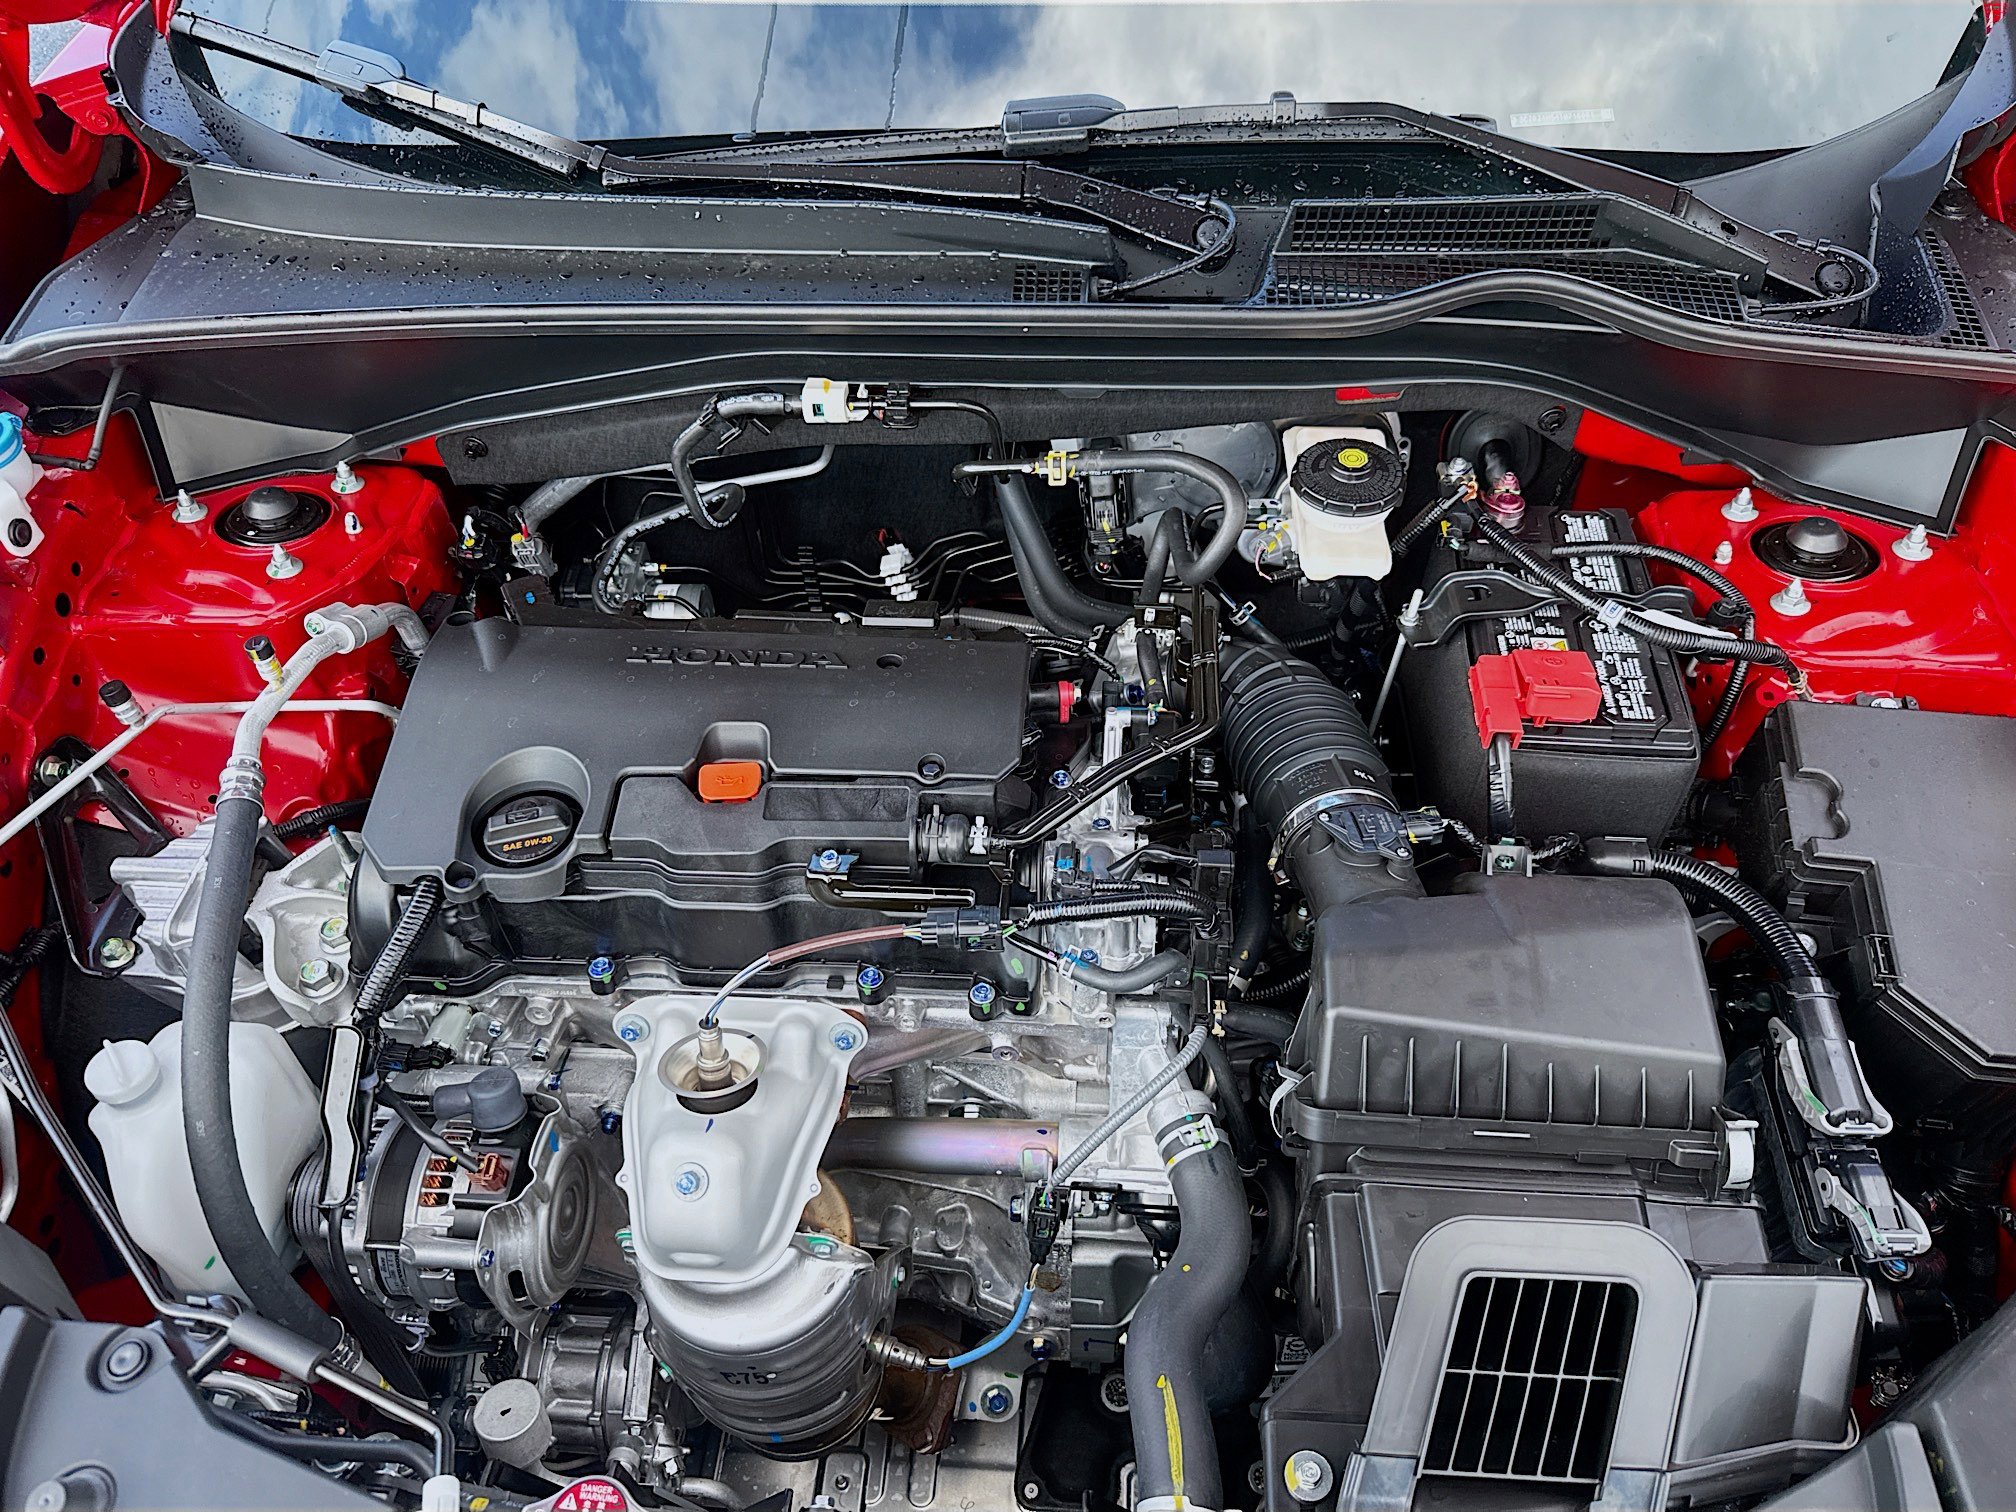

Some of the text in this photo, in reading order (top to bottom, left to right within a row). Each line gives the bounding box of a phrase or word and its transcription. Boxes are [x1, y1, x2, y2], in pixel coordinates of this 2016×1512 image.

[625, 646, 849, 670] HONDA
[502, 840, 523, 852] SAE
[524, 835, 553, 848] 0W-20
[580, 1483, 614, 1495] DANGER
[579, 1491, 619, 1504] WARNUNG
